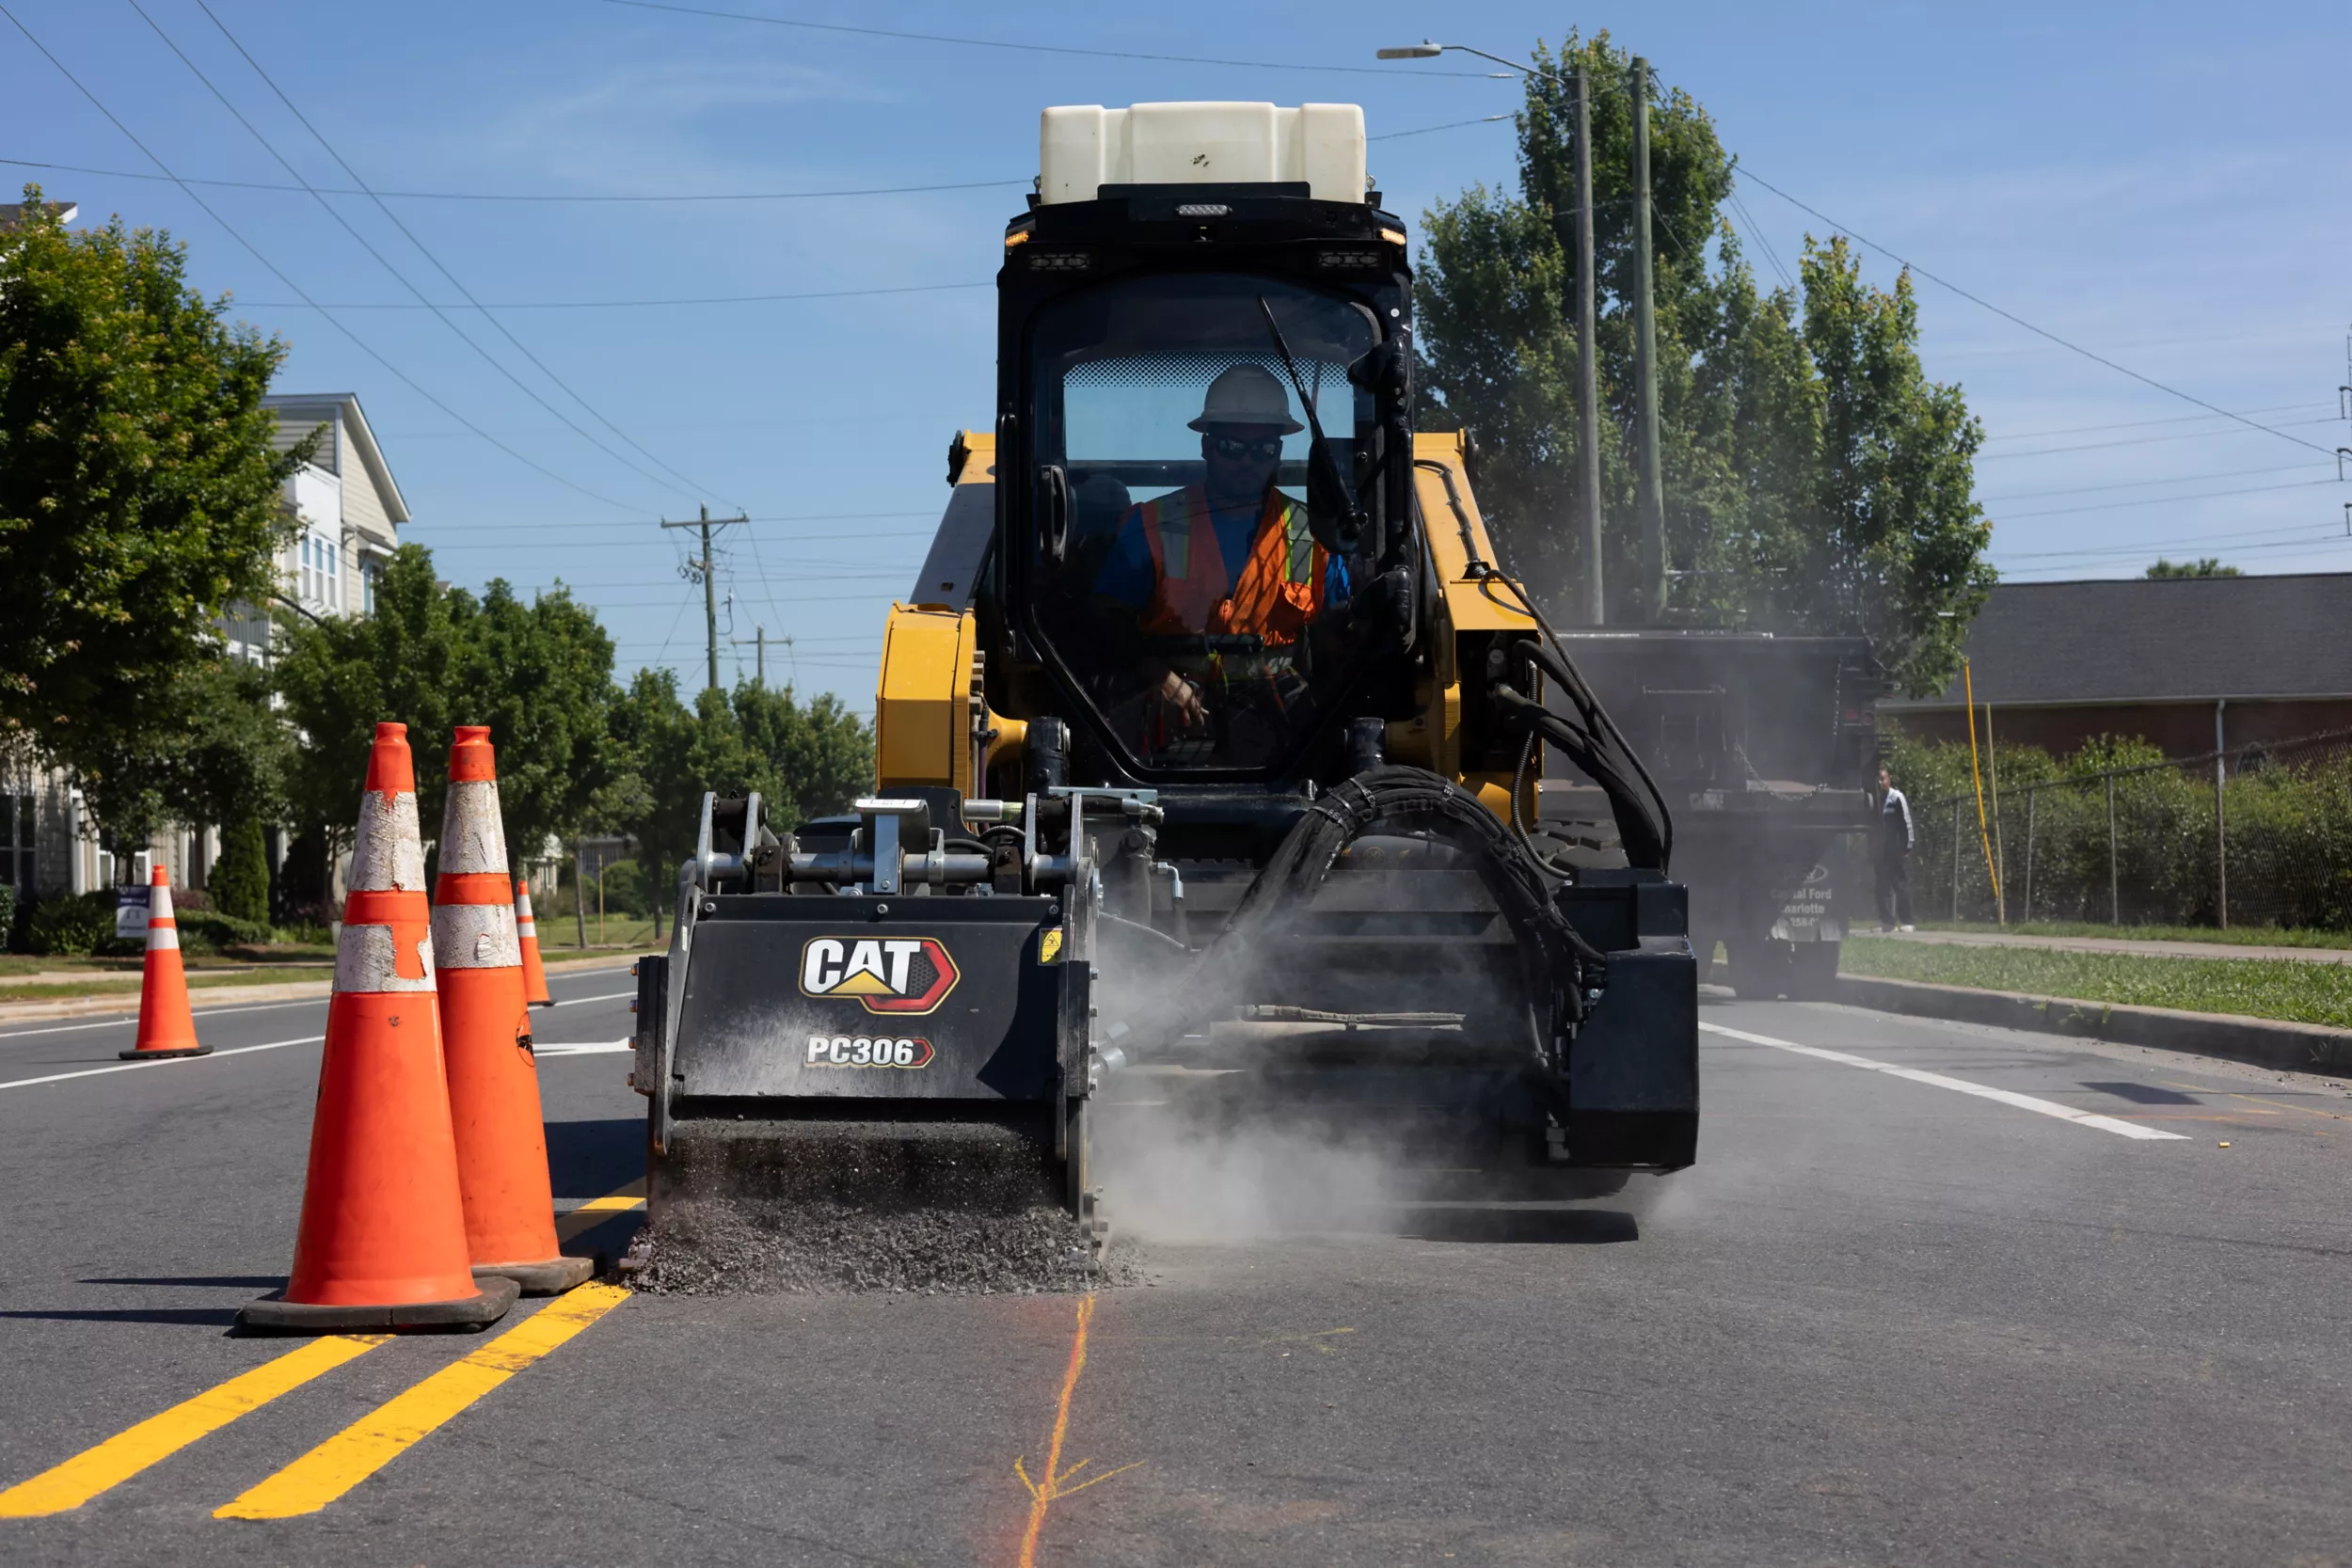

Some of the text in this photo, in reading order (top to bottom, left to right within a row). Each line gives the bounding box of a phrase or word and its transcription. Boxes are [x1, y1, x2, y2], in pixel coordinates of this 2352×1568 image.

[1808, 888, 1832, 899] Ford
[1778, 903, 1825, 914] harlotte
[804, 939, 921, 995] CAT
[807, 1037, 914, 1066] PC306
